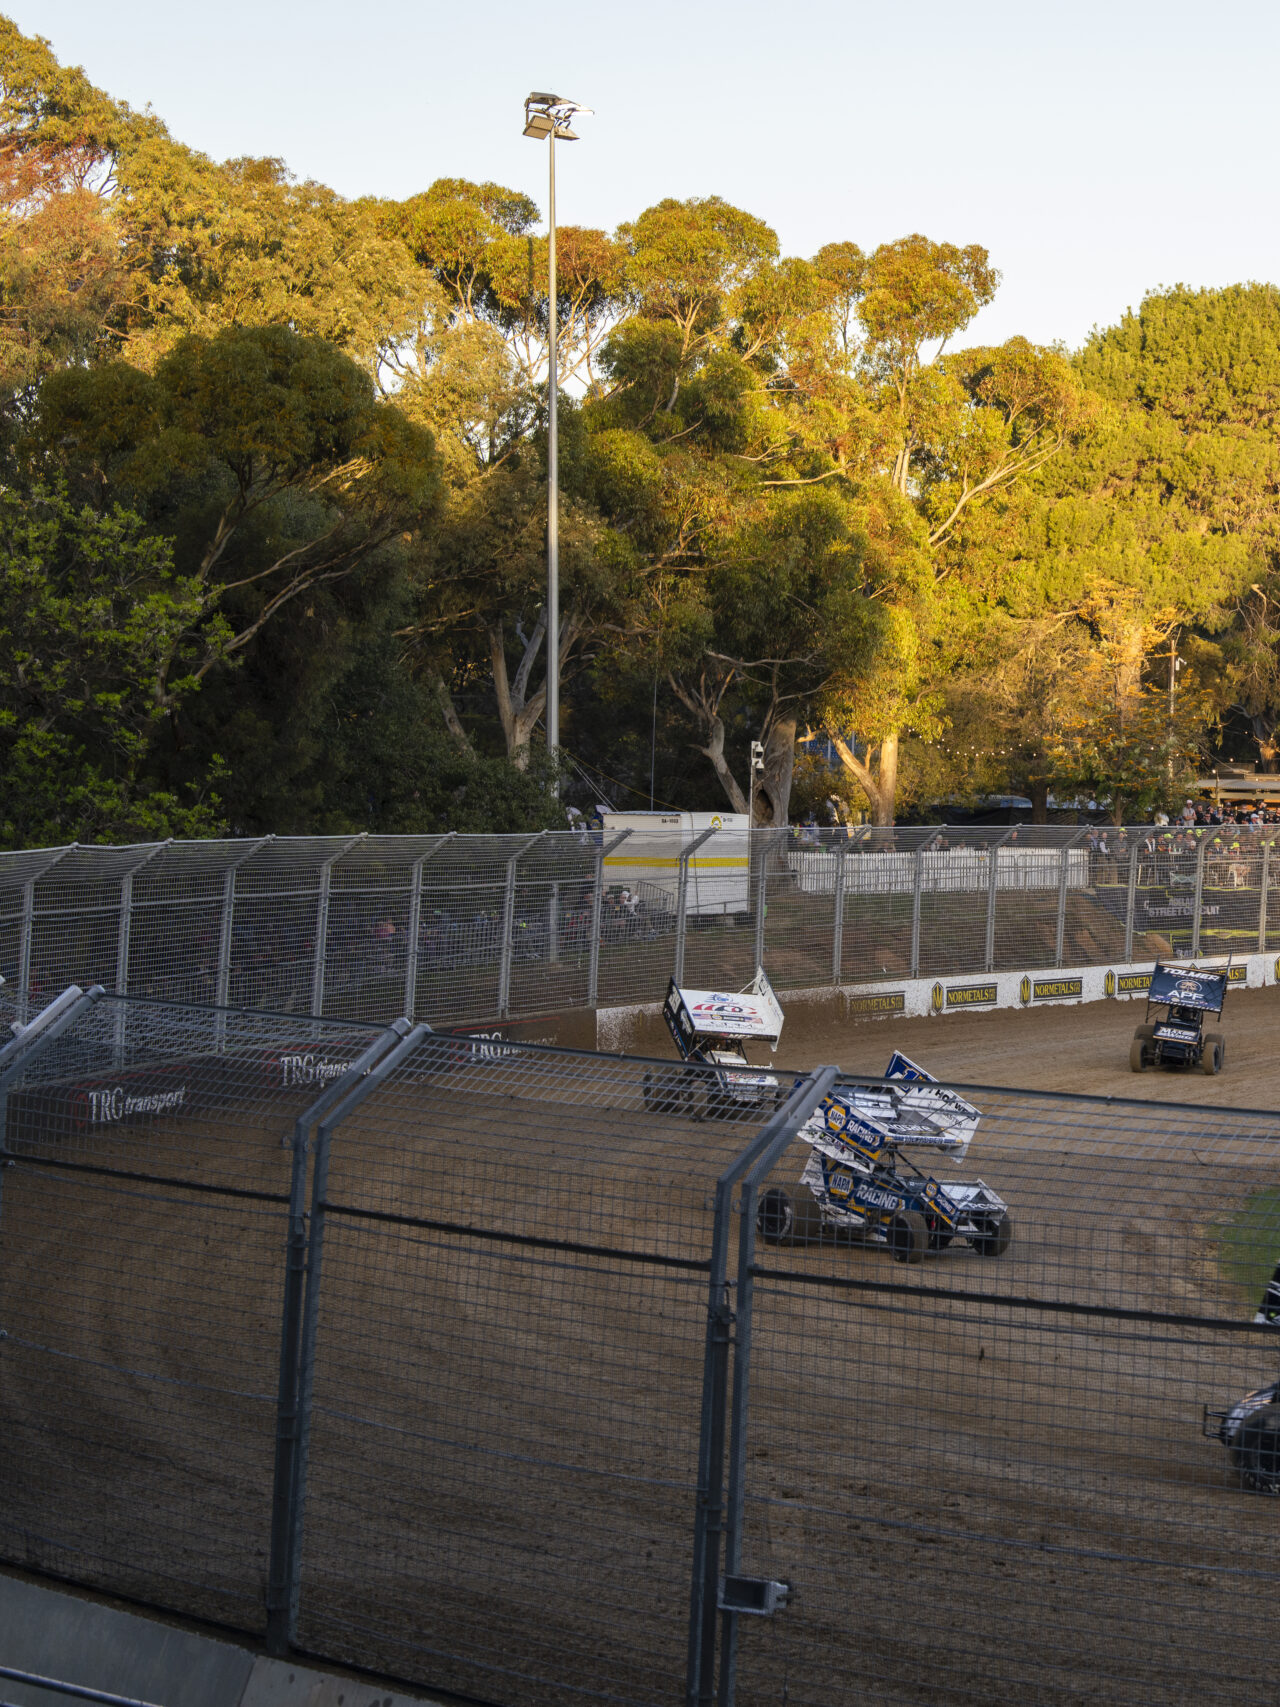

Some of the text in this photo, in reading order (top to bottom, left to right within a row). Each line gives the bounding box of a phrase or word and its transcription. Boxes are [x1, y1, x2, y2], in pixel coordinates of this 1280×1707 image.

[1163, 967, 1220, 982] TOLMER
[947, 988, 988, 1004] NORMETALS
[1034, 981, 1074, 997] NORMETALS
[1167, 989, 1206, 1000] APF
[851, 997, 896, 1013] NORMETALS
[281, 1055, 315, 1087] TRG
[88, 1085, 186, 1124] TRG transport
[846, 1120, 875, 1143] RACING
[856, 1184, 900, 1210] RACING
